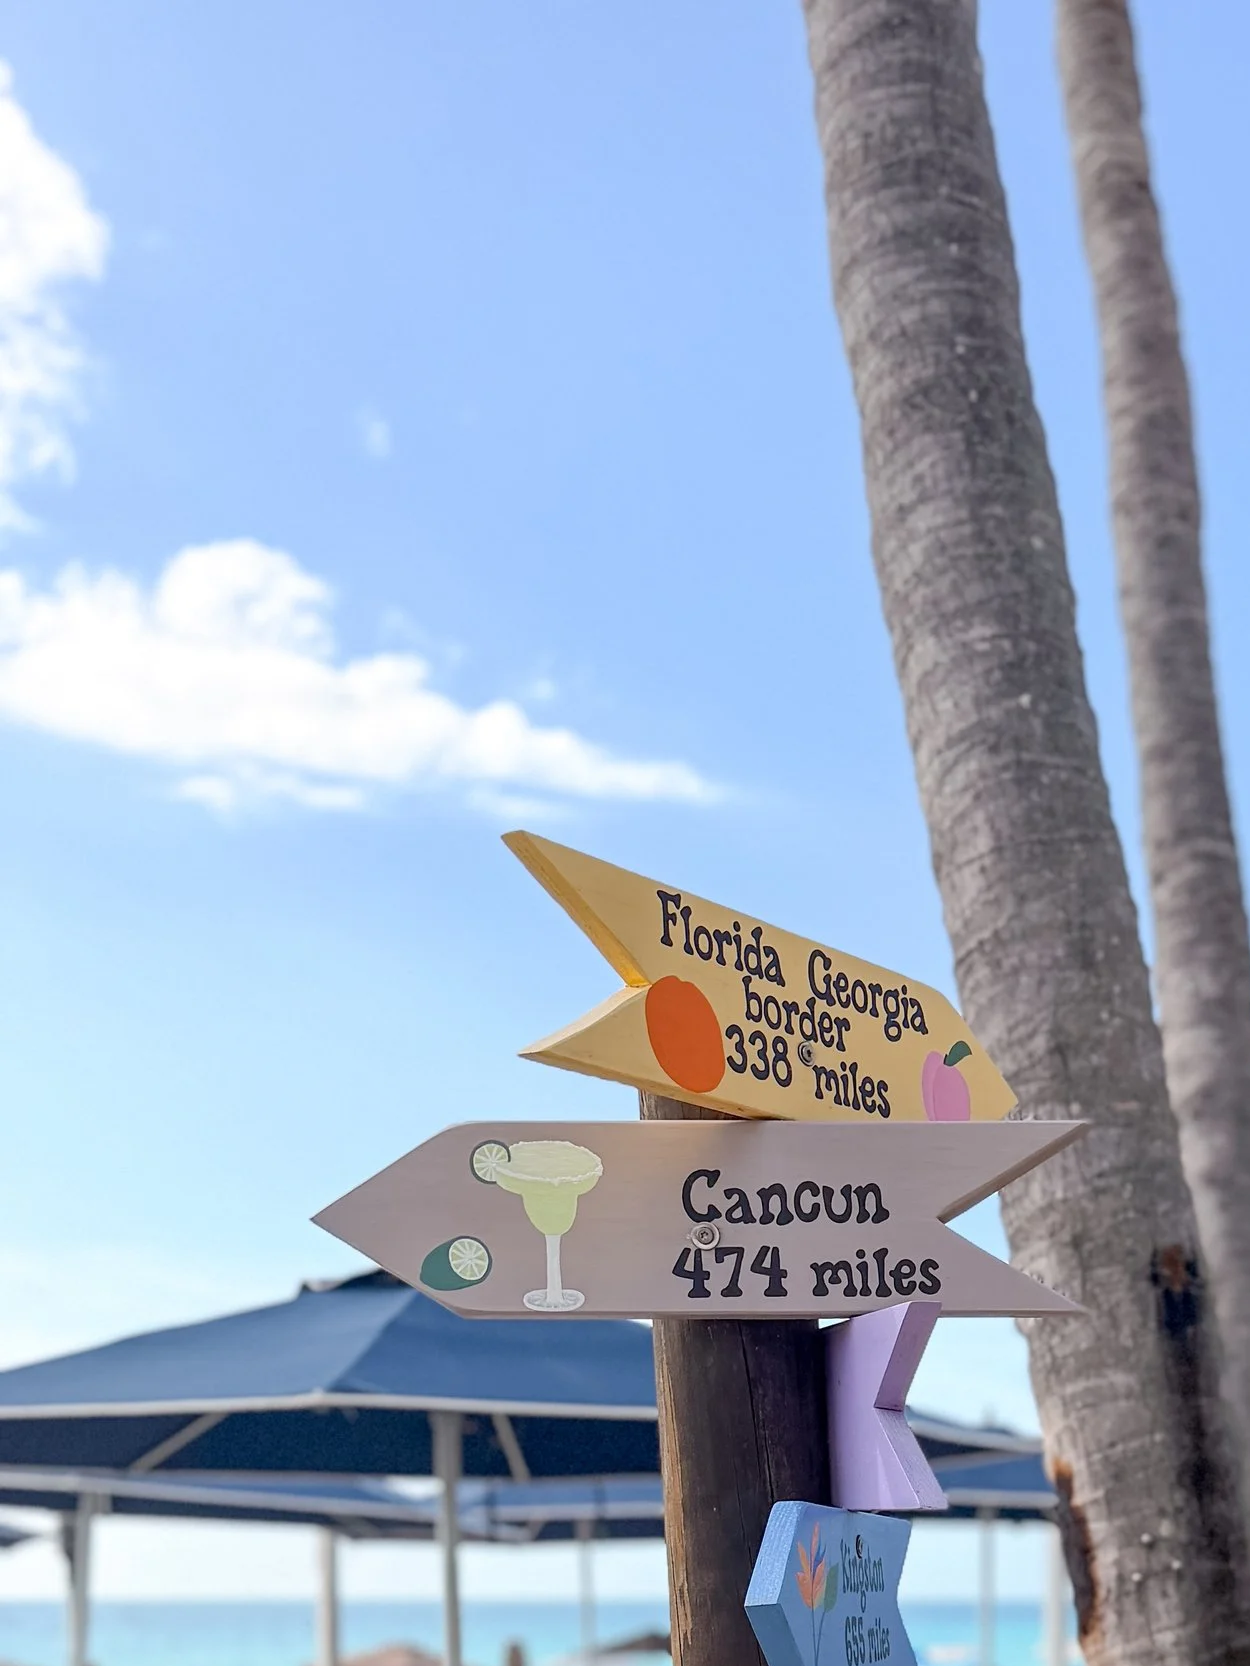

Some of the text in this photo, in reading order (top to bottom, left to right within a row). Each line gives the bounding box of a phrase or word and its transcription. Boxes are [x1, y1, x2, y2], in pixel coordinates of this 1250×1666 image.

[657, 889, 929, 1042] Florida Georgia
[742, 975, 850, 1052] border
[725, 1023, 891, 1119] 338 miles
[681, 1169, 890, 1226] Cancun
[671, 1245, 941, 1299] 474 miles
[840, 1538, 885, 1613] Kingston
[867, 1616, 891, 1664] miles
